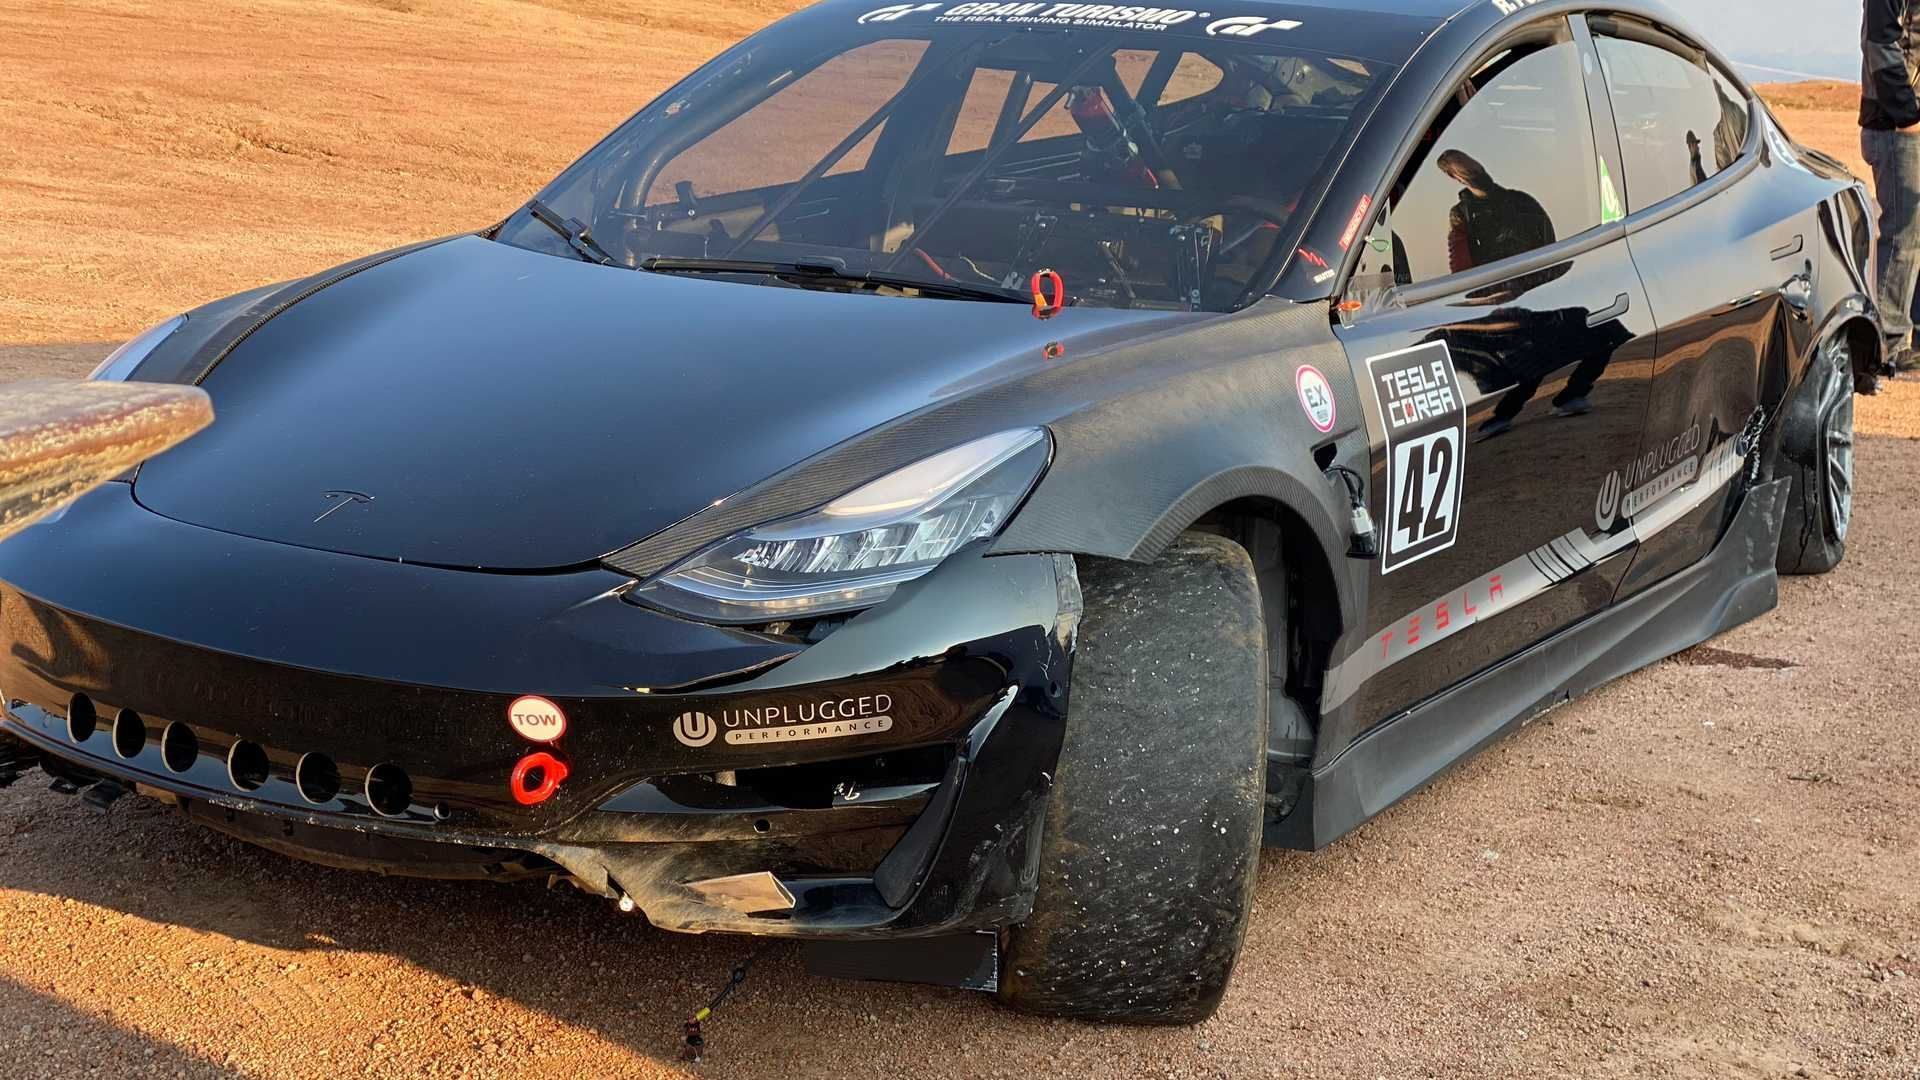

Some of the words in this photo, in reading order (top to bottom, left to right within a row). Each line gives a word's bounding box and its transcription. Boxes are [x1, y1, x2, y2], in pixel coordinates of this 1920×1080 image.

[934, 15, 963, 23] THE
[964, 15, 1002, 23] REAL
[1006, 16, 1071, 25] DRIVING
[1072, 18, 1168, 31] SIMULATOR
[943, 2, 1047, 16] GRAN
[1039, 3, 1197, 25] TURISMO
[1303, 383, 1328, 409] EX
[1381, 360, 1449, 399] TESLA
[1388, 386, 1457, 428] CORSA
[1623, 423, 1700, 489] UNPLUGGED
[1397, 436, 1453, 545] 42
[1624, 459, 1696, 512] PERFORMANCE
[1379, 575, 1504, 659] TESLA
[513, 713, 557, 727] TOW
[722, 694, 893, 728] UNPLUGGED
[733, 718, 886, 742] PERFORMANCE
